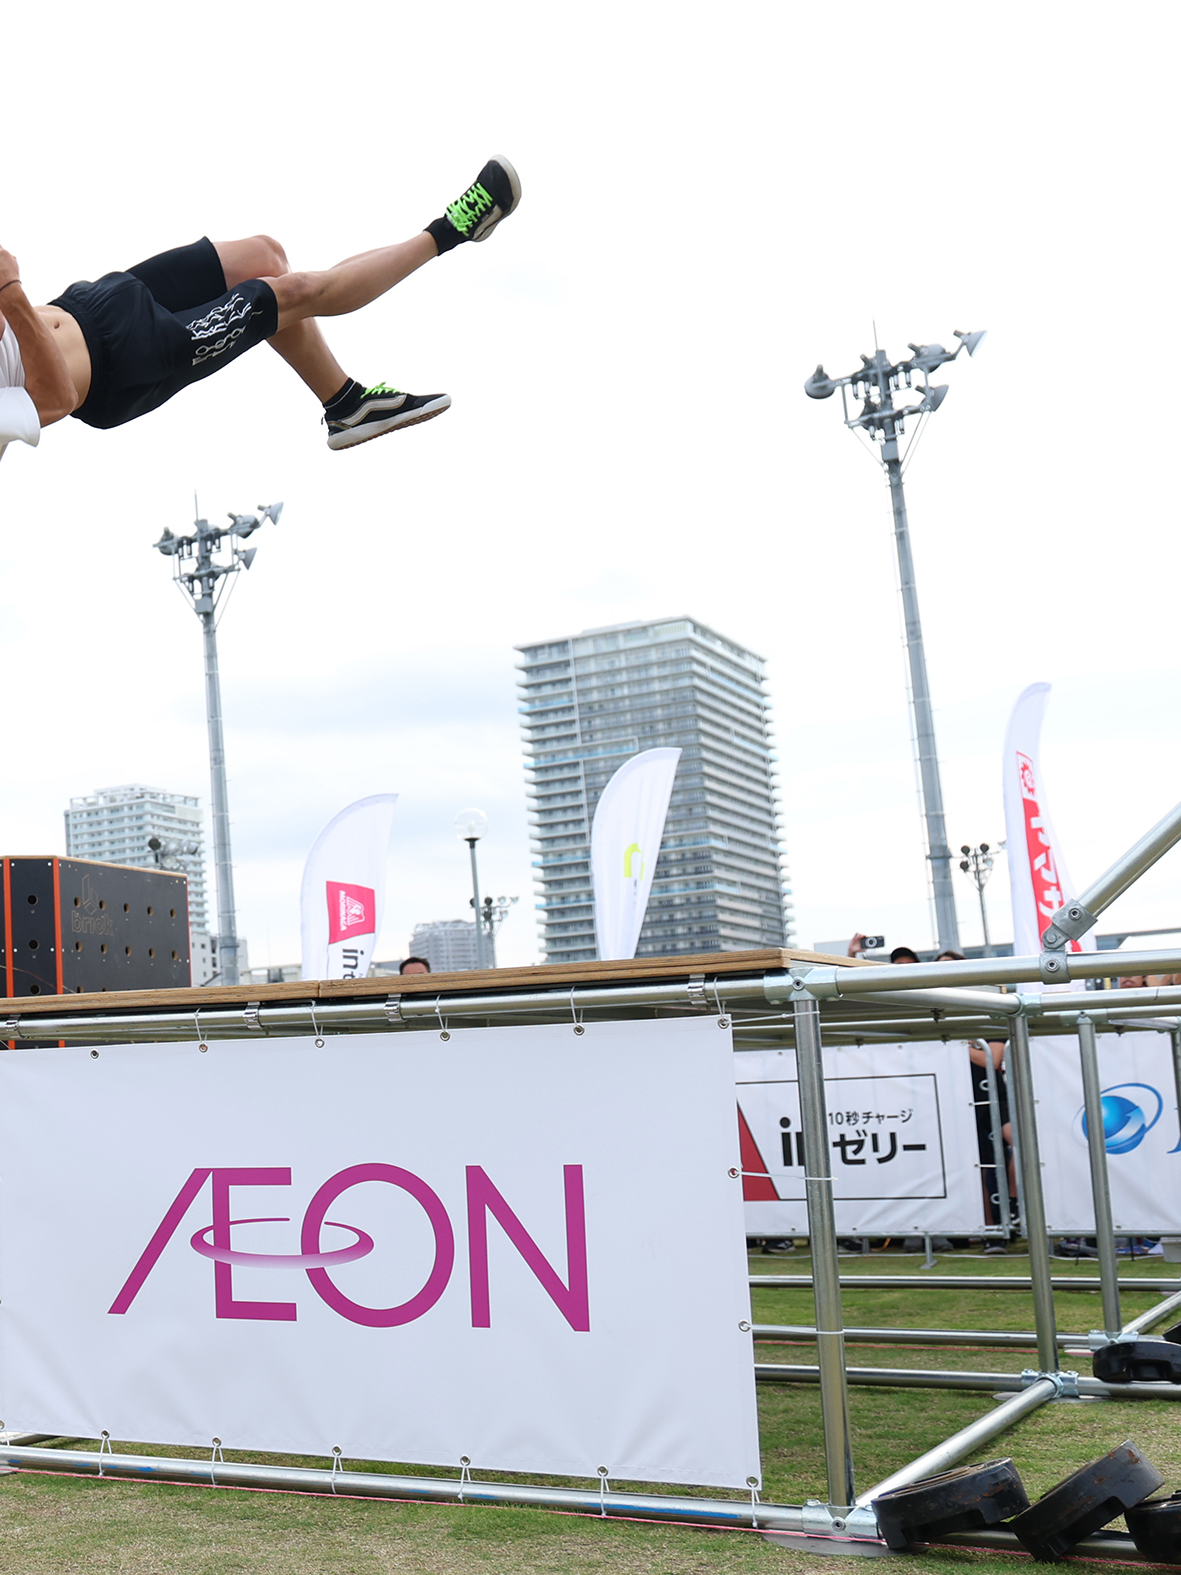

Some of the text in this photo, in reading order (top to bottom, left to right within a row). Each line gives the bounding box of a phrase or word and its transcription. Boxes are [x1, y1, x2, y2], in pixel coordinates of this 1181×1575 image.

[71, 910, 114, 936] brick
[828, 1109, 913, 1126] 10秒チャージ
